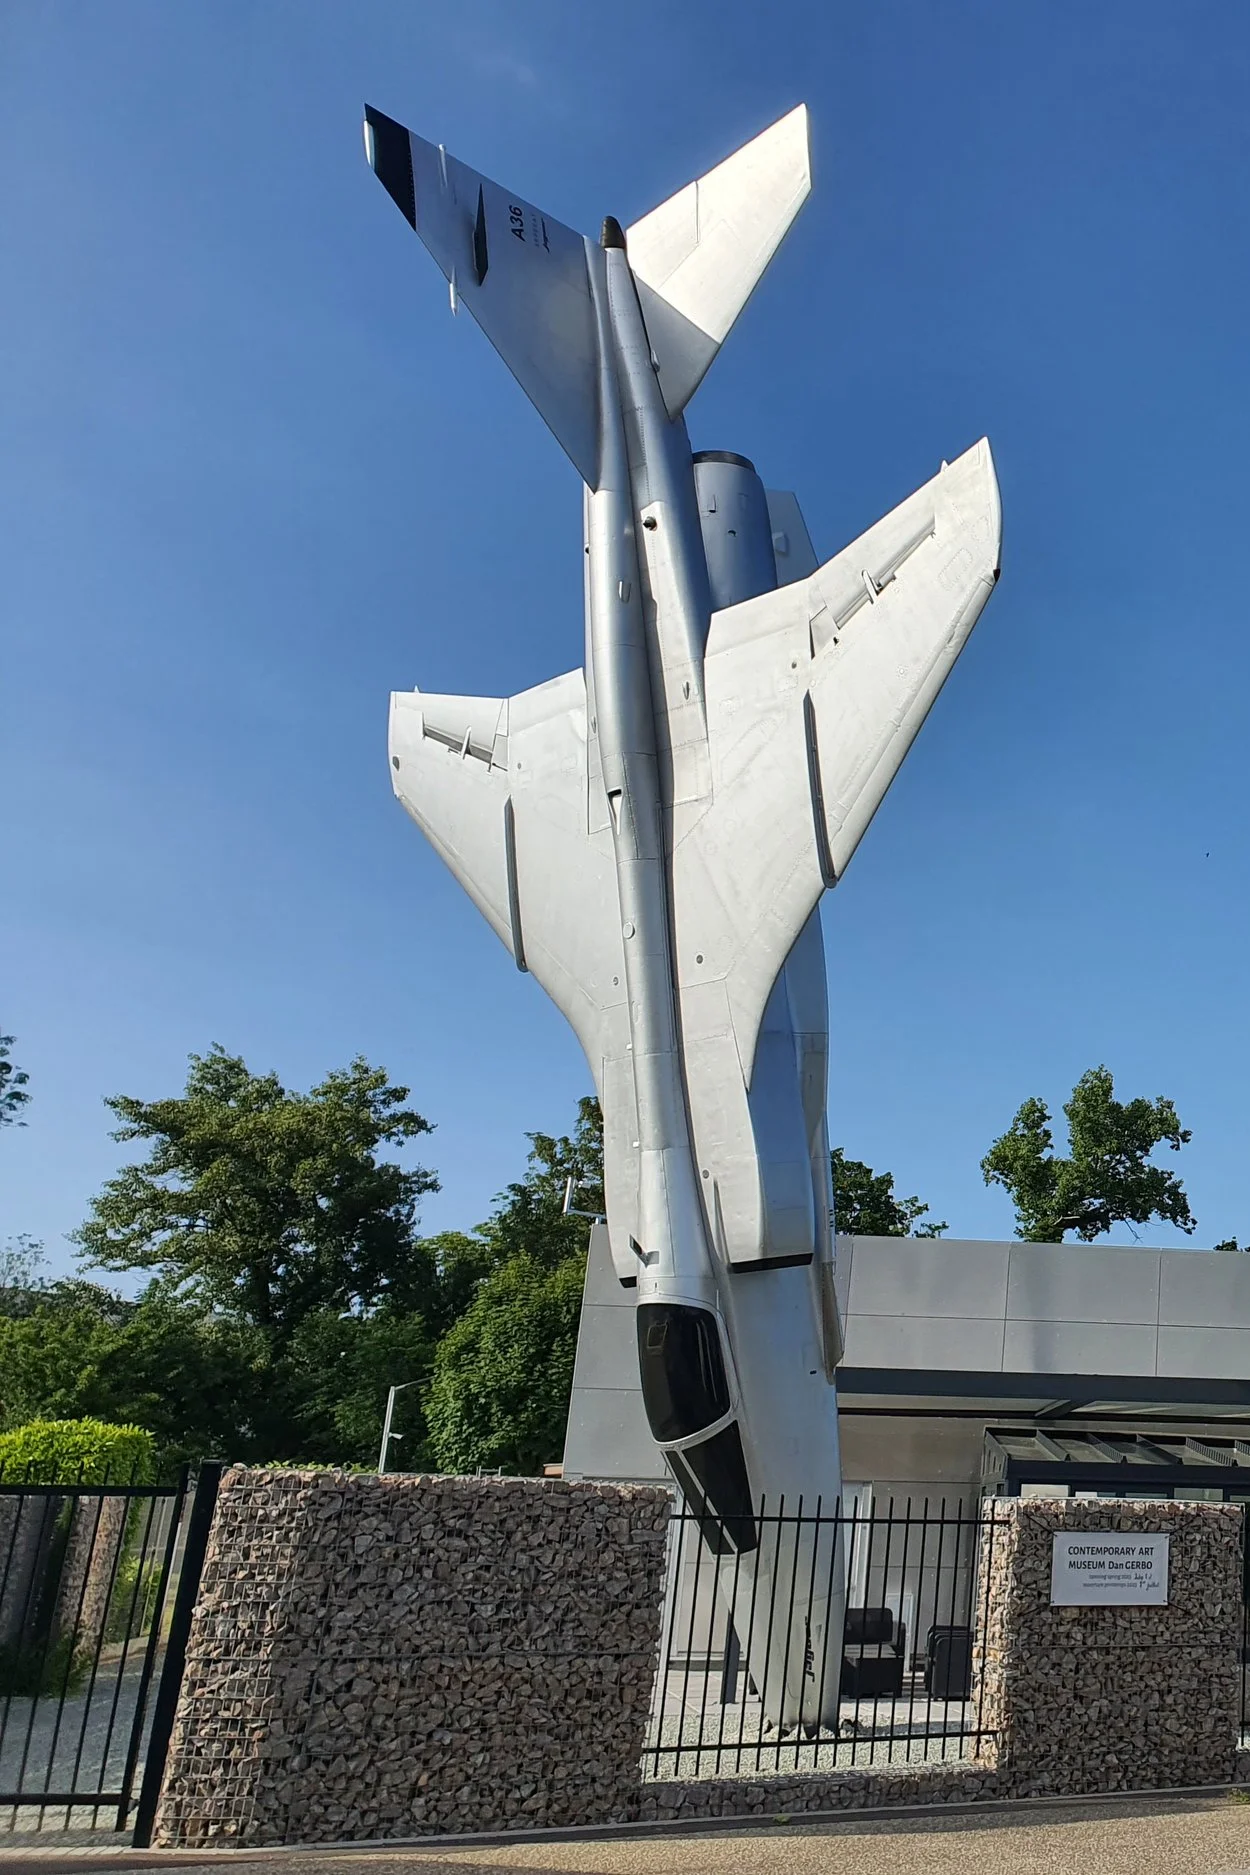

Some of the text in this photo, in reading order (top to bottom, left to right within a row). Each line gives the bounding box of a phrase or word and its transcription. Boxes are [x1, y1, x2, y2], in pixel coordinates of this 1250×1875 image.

[508, 204, 526, 242] A36
[1068, 1546, 1154, 1556] CONTEMPORARY ART
[1068, 1561, 1153, 1570] MUSEUM Dan GERBO
